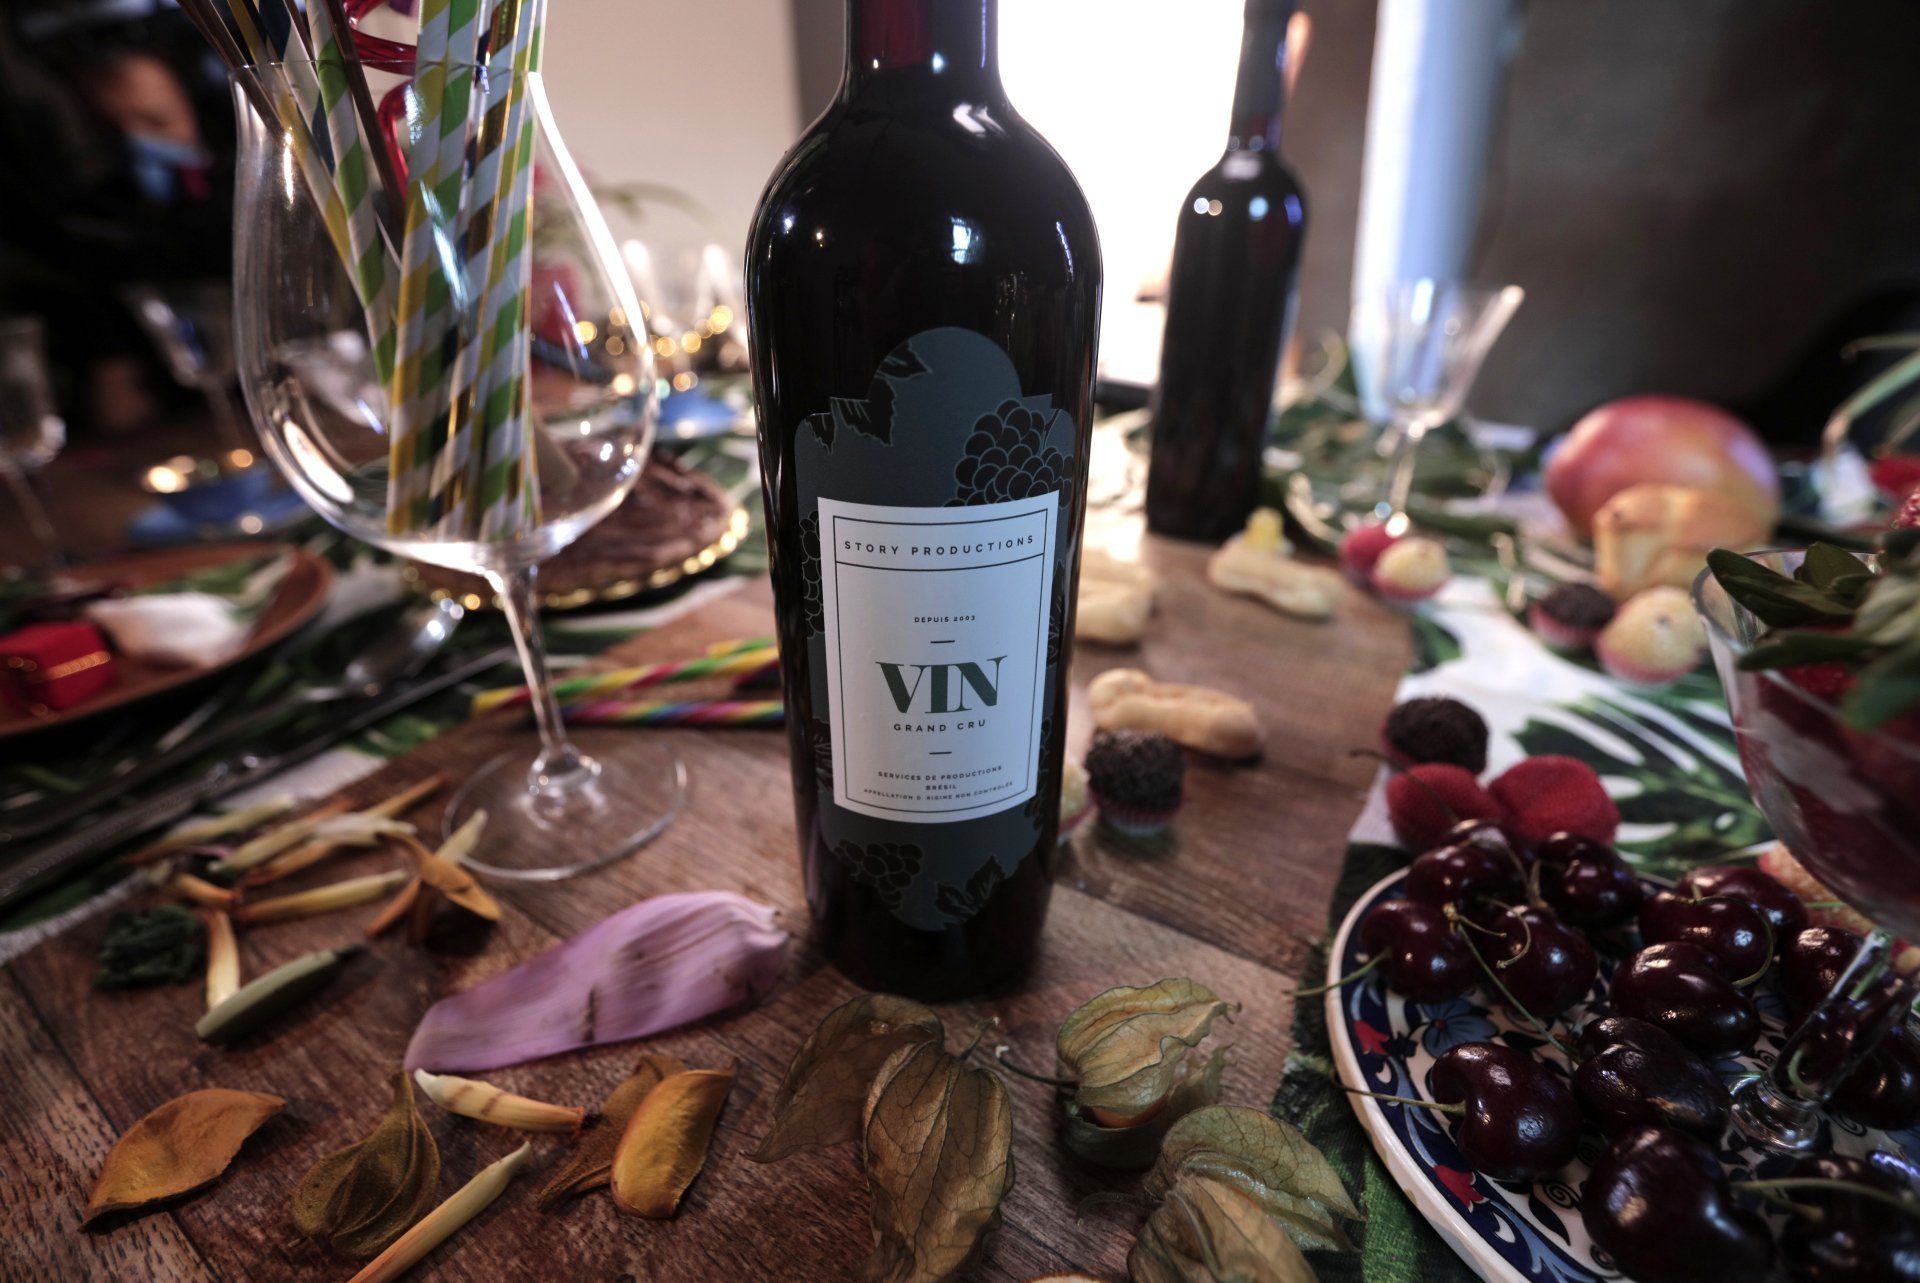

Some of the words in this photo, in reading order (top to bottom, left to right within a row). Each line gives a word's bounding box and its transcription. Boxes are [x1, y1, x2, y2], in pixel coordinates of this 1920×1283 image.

[844, 541, 899, 555] STORY
[911, 535, 1033, 556] PRODUCTIONS
[953, 614, 976, 622] 2003
[875, 655, 1008, 714] VIN
[893, 723, 947, 732] GRAND
[957, 719, 986, 730] CRU
[878, 771, 921, 781] SERVICES
[940, 765, 1003, 780] PRODUCTIONS
